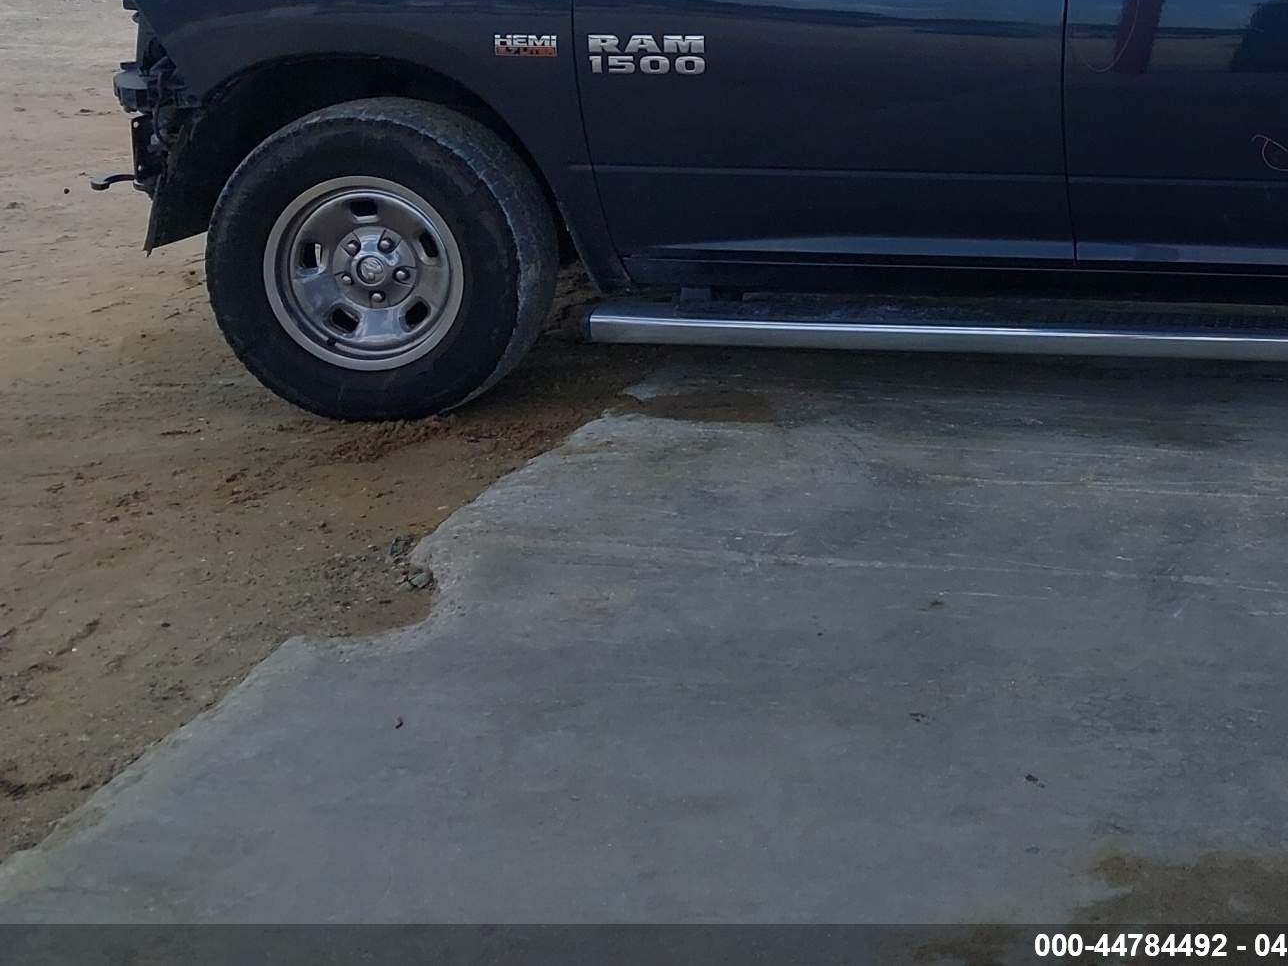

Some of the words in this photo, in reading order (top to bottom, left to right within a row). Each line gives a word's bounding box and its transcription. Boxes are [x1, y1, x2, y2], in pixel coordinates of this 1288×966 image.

[494, 34, 557, 46] HEMI
[587, 34, 705, 54] RAM
[588, 55, 706, 75] 1500
